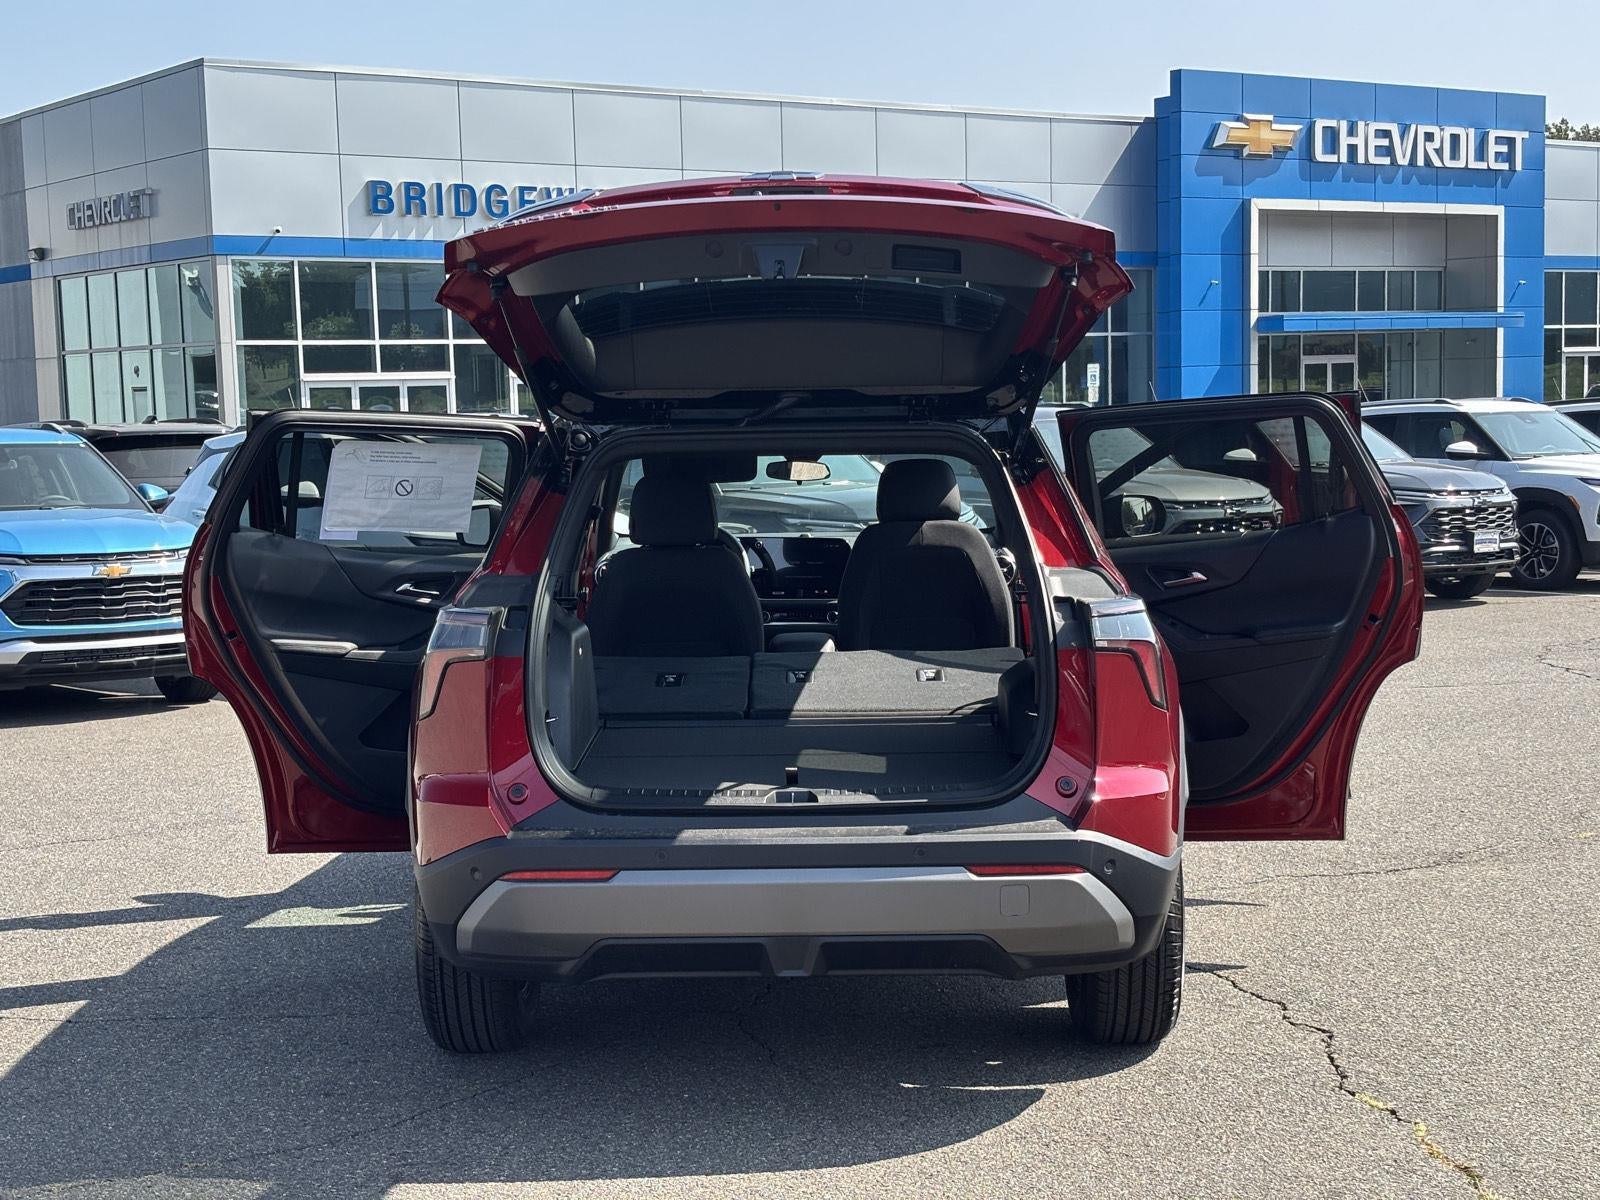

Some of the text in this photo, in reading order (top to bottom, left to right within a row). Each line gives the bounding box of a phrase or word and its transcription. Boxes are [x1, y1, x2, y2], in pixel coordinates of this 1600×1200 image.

[1313, 118, 1529, 171] CHEVROLET
[66, 188, 152, 230] CHEVROLET
[367, 180, 592, 219] BRIDGE
